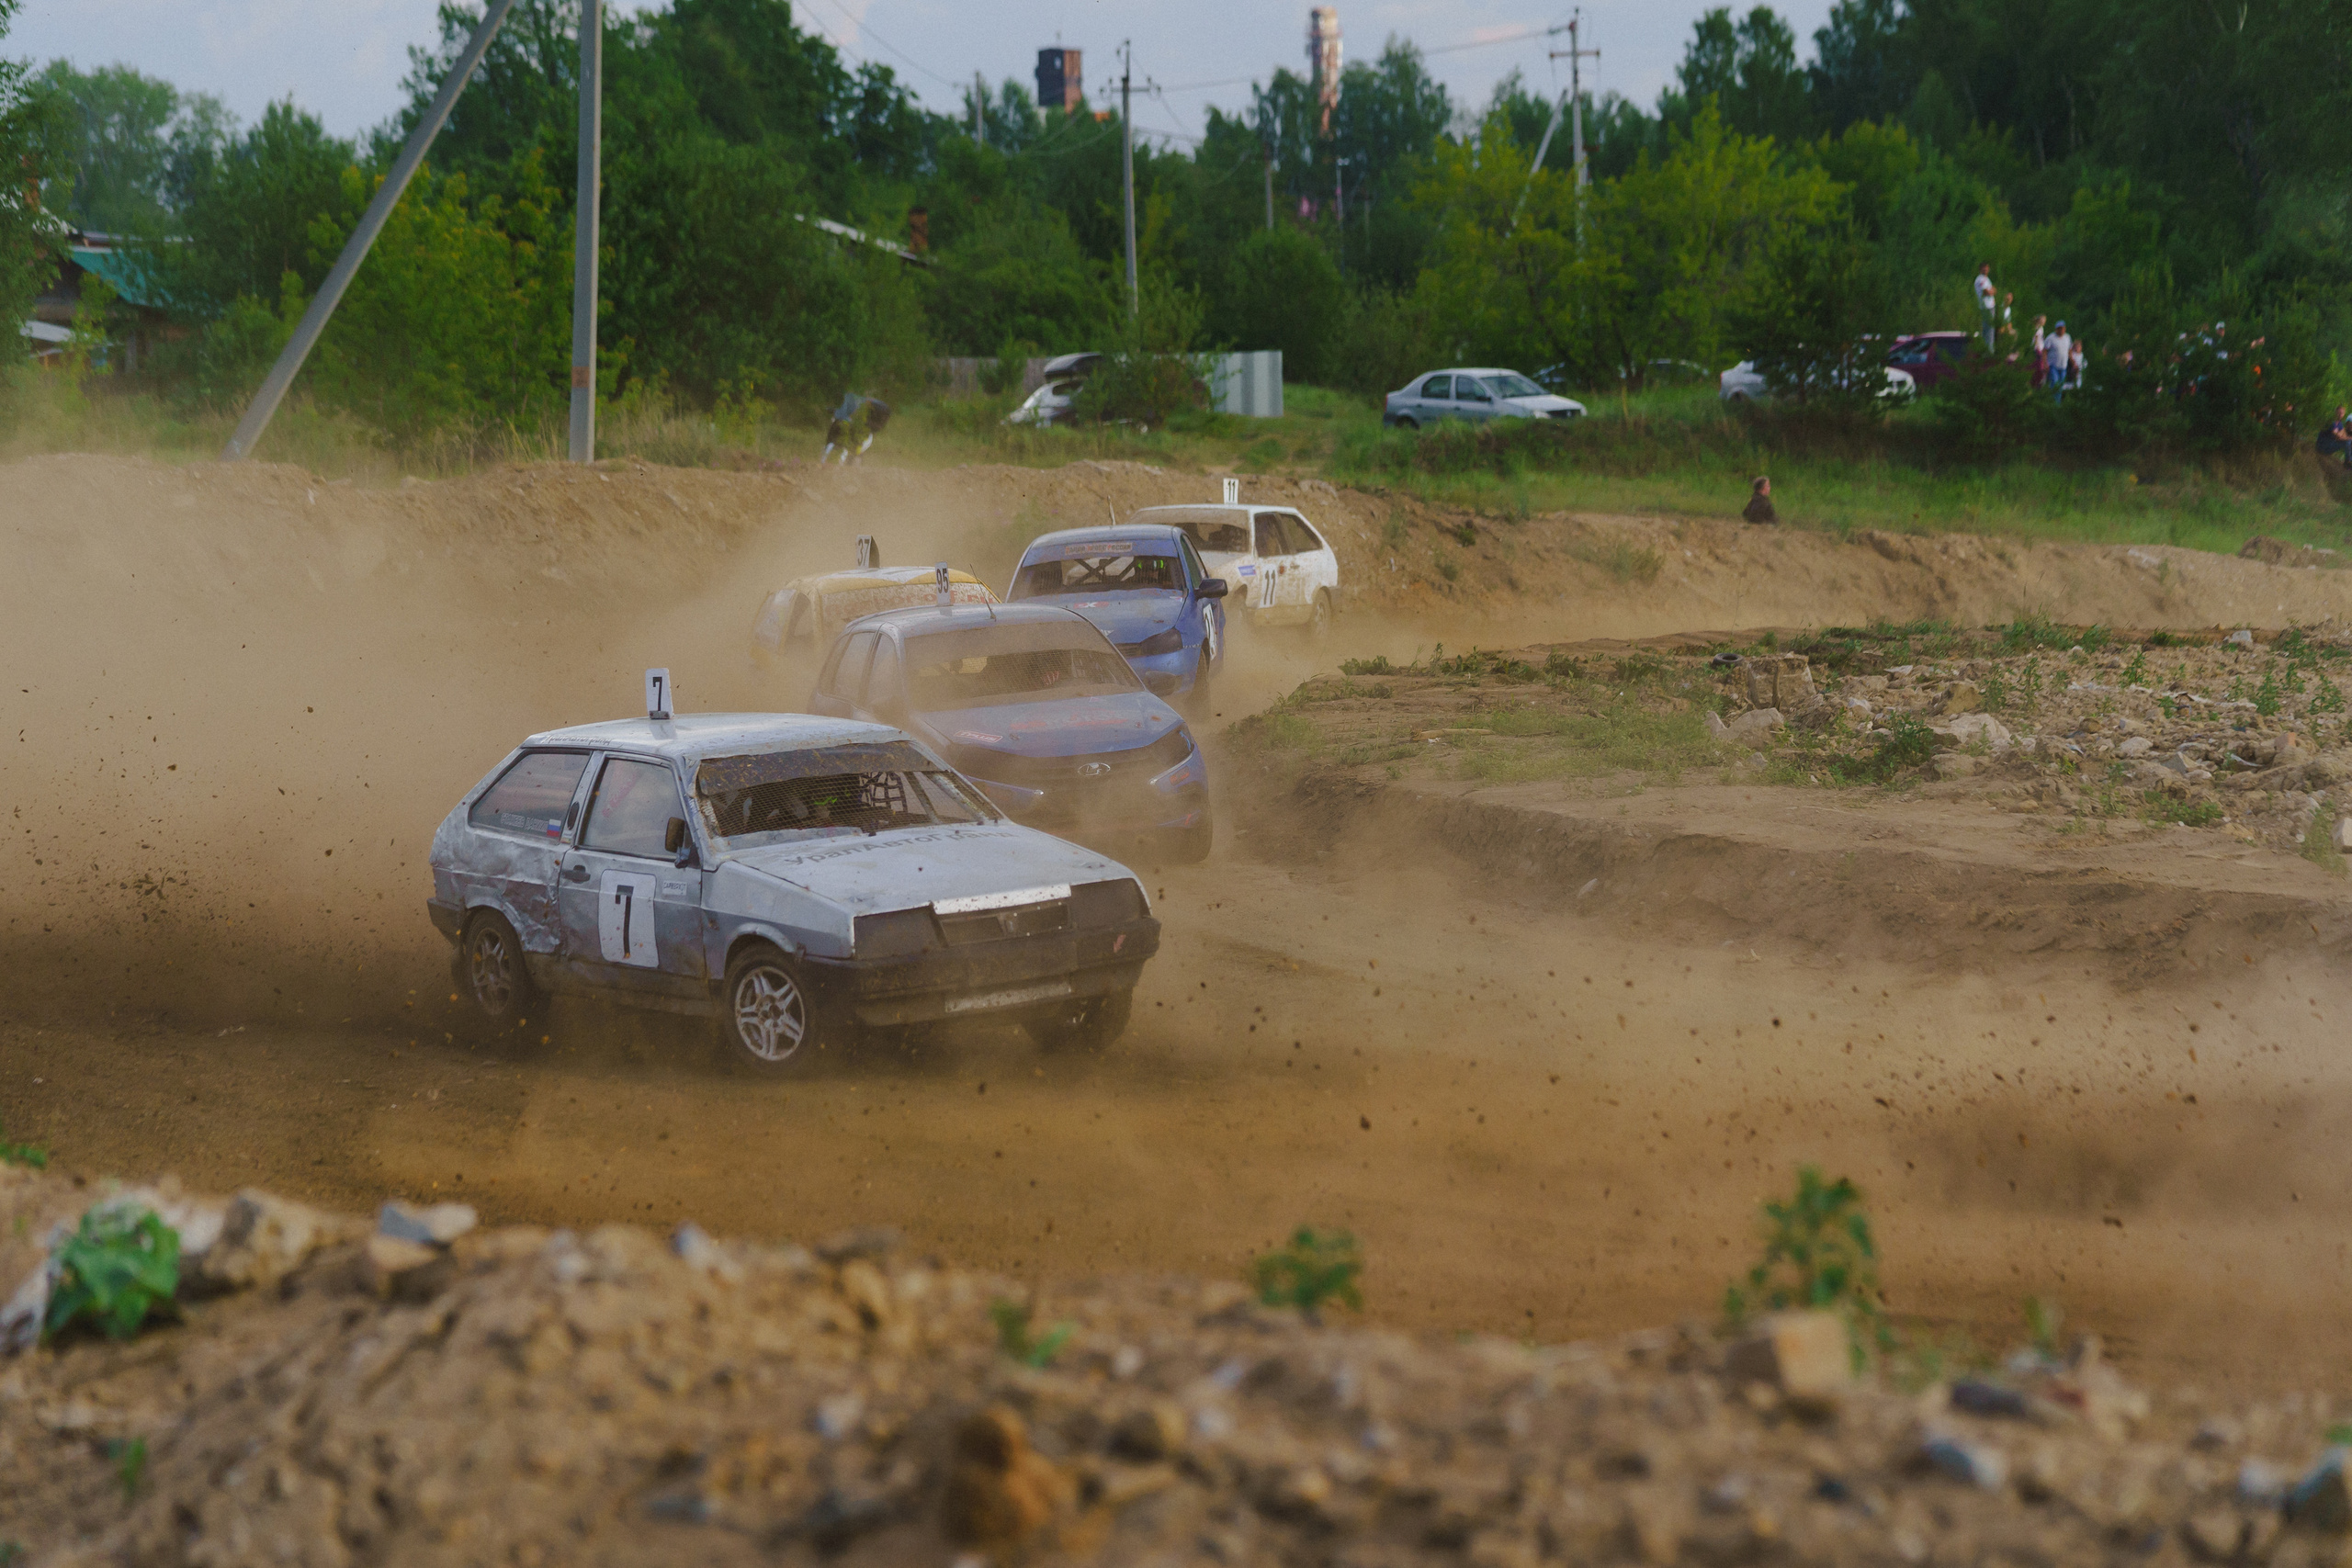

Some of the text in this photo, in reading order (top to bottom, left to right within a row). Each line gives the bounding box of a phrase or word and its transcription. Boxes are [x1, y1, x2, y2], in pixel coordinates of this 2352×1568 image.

[1227, 480, 1236, 502] 11
[857, 538, 870, 567] 37
[936, 569, 949, 594] 95
[1264, 570, 1276, 605] 11
[652, 676, 662, 712] 7
[615, 885, 634, 958] 7
